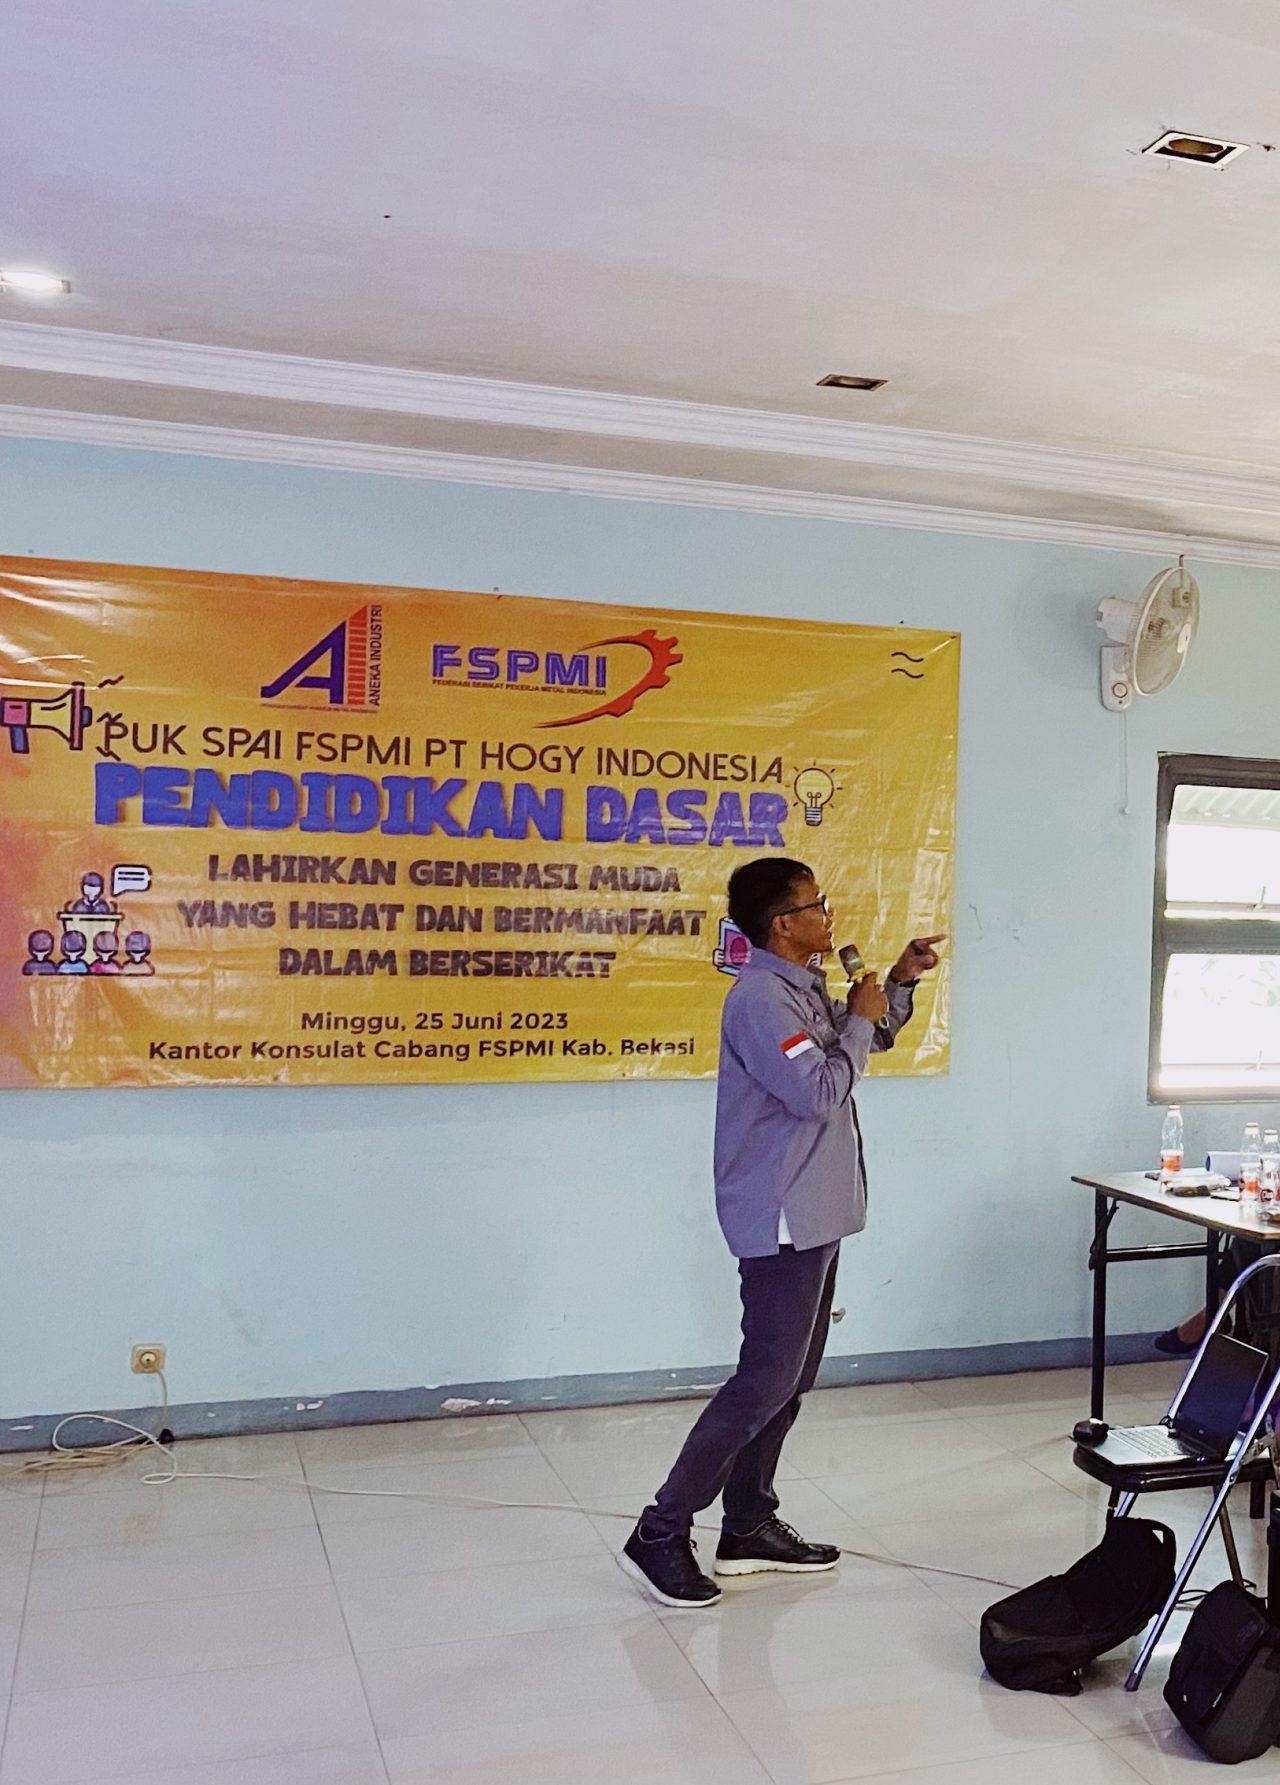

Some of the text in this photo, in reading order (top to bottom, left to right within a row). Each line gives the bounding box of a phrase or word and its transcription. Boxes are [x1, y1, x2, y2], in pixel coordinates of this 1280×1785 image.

[368, 604, 382, 707] ANEKA INDUSTRI
[432, 644, 607, 688] FSPMI
[505, 683, 539, 692] PEKERJA
[104, 722, 784, 784] PUK SPAI FSPMI PT HOGY INDONESIA
[94, 761, 790, 848] PENDIDIKAN DASAR
[208, 854, 682, 893] LAHIRKAN GENERASI MUDA
[177, 899, 707, 936] YANG HEBAT DAN BERMANFAAT
[279, 947, 616, 979] DALAM BERSERIKAT
[301, 1011, 569, 1035] Minggu, 25 Juni 2023
[149, 1037, 695, 1062] Kantor Konsulat Cabang FSPMI Kab. Bekasi
